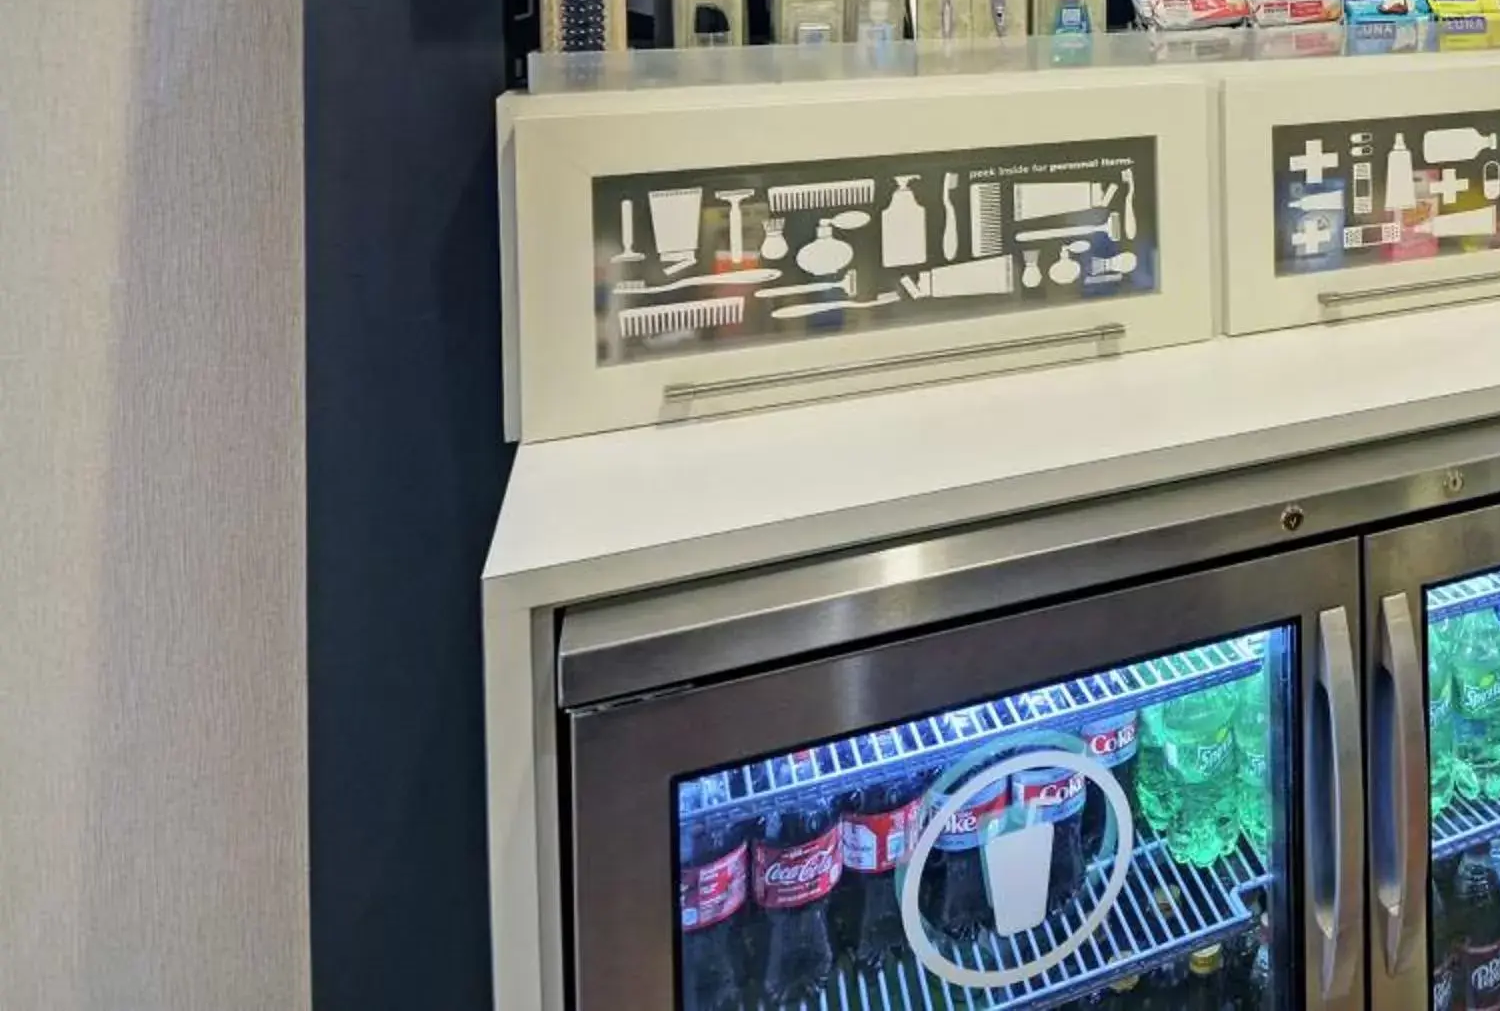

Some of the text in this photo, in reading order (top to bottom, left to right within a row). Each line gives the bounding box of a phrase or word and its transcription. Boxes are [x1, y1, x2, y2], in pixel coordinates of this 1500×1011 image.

[969, 168, 995, 180] peek
[998, 164, 1030, 177] inside
[1049, 158, 1099, 173] personal
[1089, 723, 1137, 755] Coke
